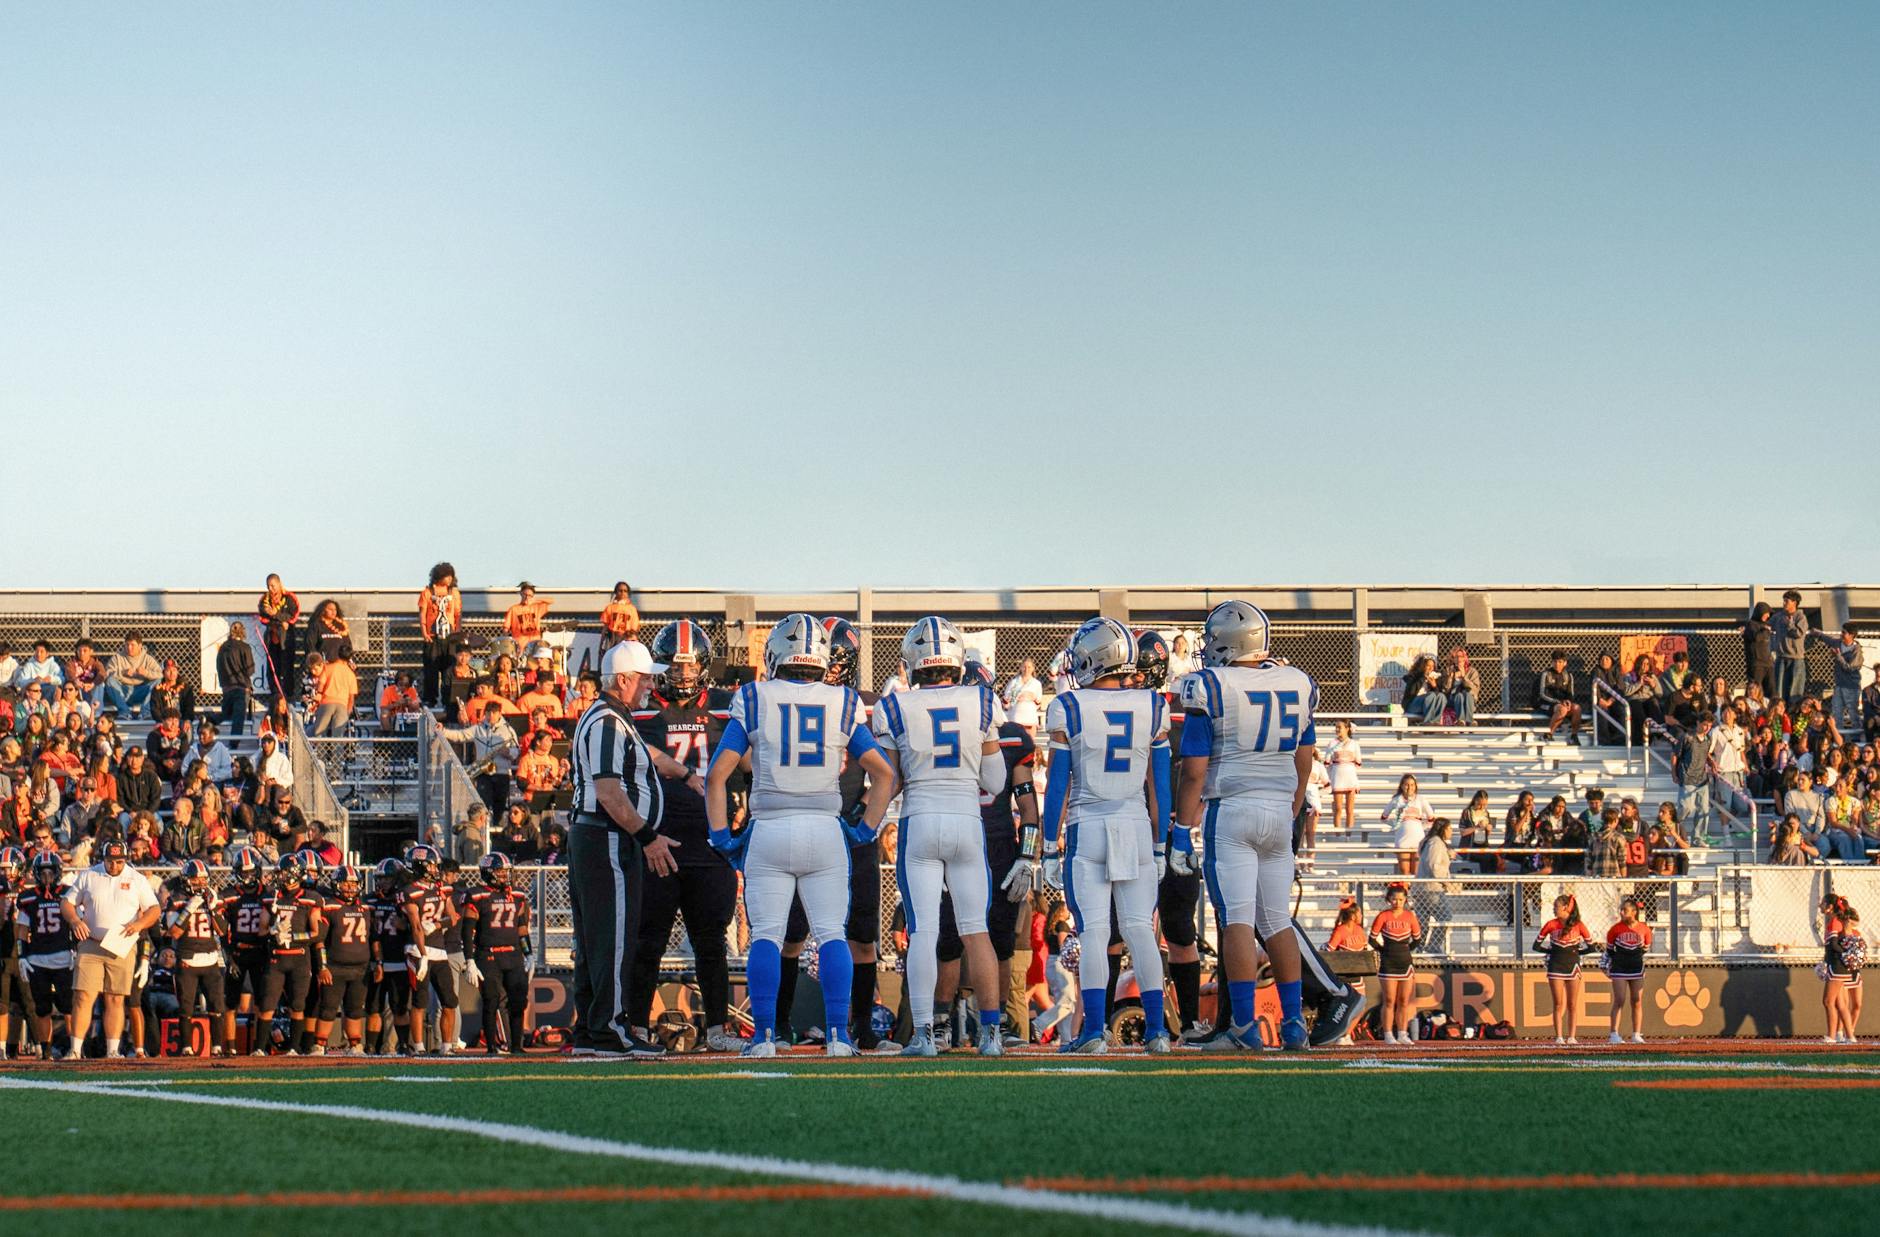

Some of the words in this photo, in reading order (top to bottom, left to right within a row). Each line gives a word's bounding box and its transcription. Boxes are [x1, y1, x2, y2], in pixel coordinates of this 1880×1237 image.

[792, 655, 822, 664] Riddell
[922, 658, 952, 666] Riddell
[667, 724, 705, 732] BEARCATS
[1245, 690, 1299, 752] 75
[777, 703, 826, 767] 19
[926, 707, 961, 769] 5
[1103, 710, 1134, 773] 2
[666, 732, 709, 776] 71
[1625, 840, 1646, 865] 19
[37, 907, 61, 934] 15
[187, 912, 211, 938] 12
[237, 908, 263, 933] 22
[490, 903, 517, 928] 77
[341, 917, 367, 944] 74
[1408, 972, 1613, 1027] PRIDE
[1331, 1002, 1349, 1024] HOKA
